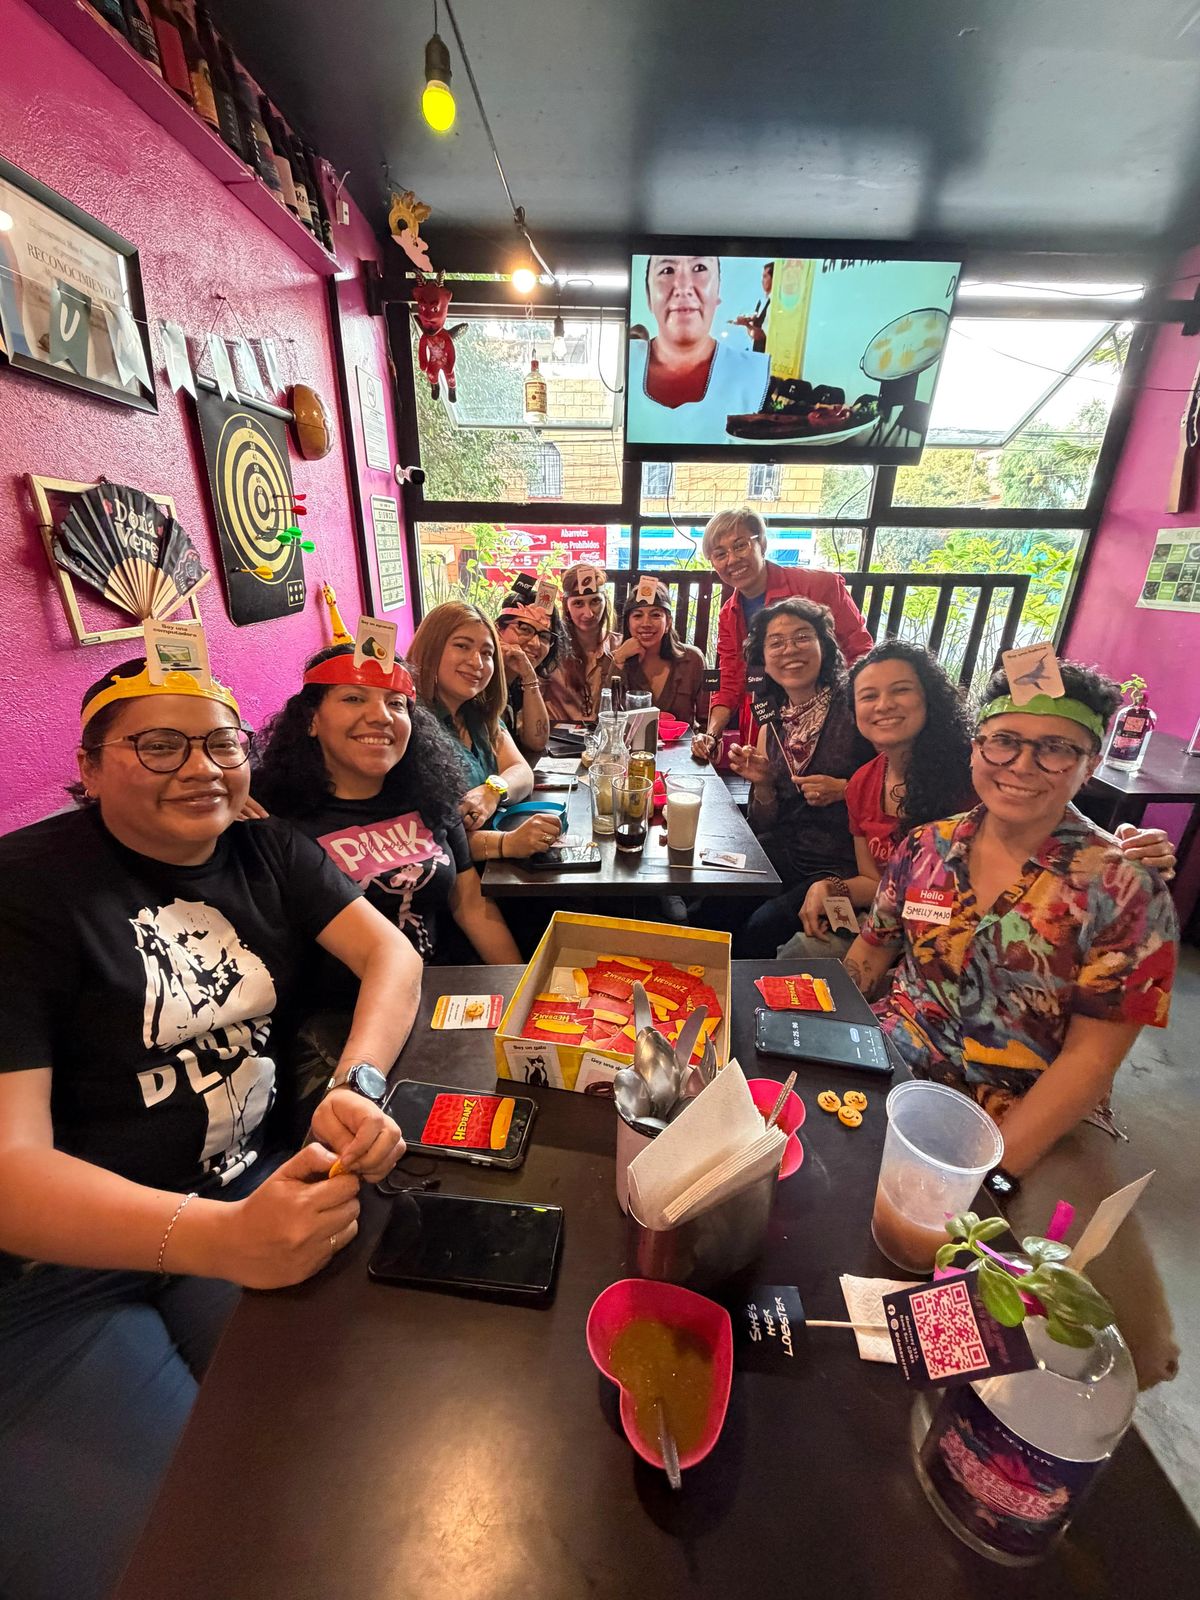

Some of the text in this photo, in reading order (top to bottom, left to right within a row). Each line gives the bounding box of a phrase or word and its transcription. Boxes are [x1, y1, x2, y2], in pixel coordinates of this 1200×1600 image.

[26, 242, 116, 300] RECONOCIMIENTO
[560, 529, 589, 538] Abarrotes
[569, 540, 600, 549] Prohibidos
[330, 820, 432, 872] PINK
[920, 889, 944, 901] Hello
[906, 905, 951, 920] SMELLY MAJO
[451, 1098, 478, 1141] HEDBANZ
[763, 1308, 777, 1337] HER
[774, 1296, 794, 1357] LOBSTER
